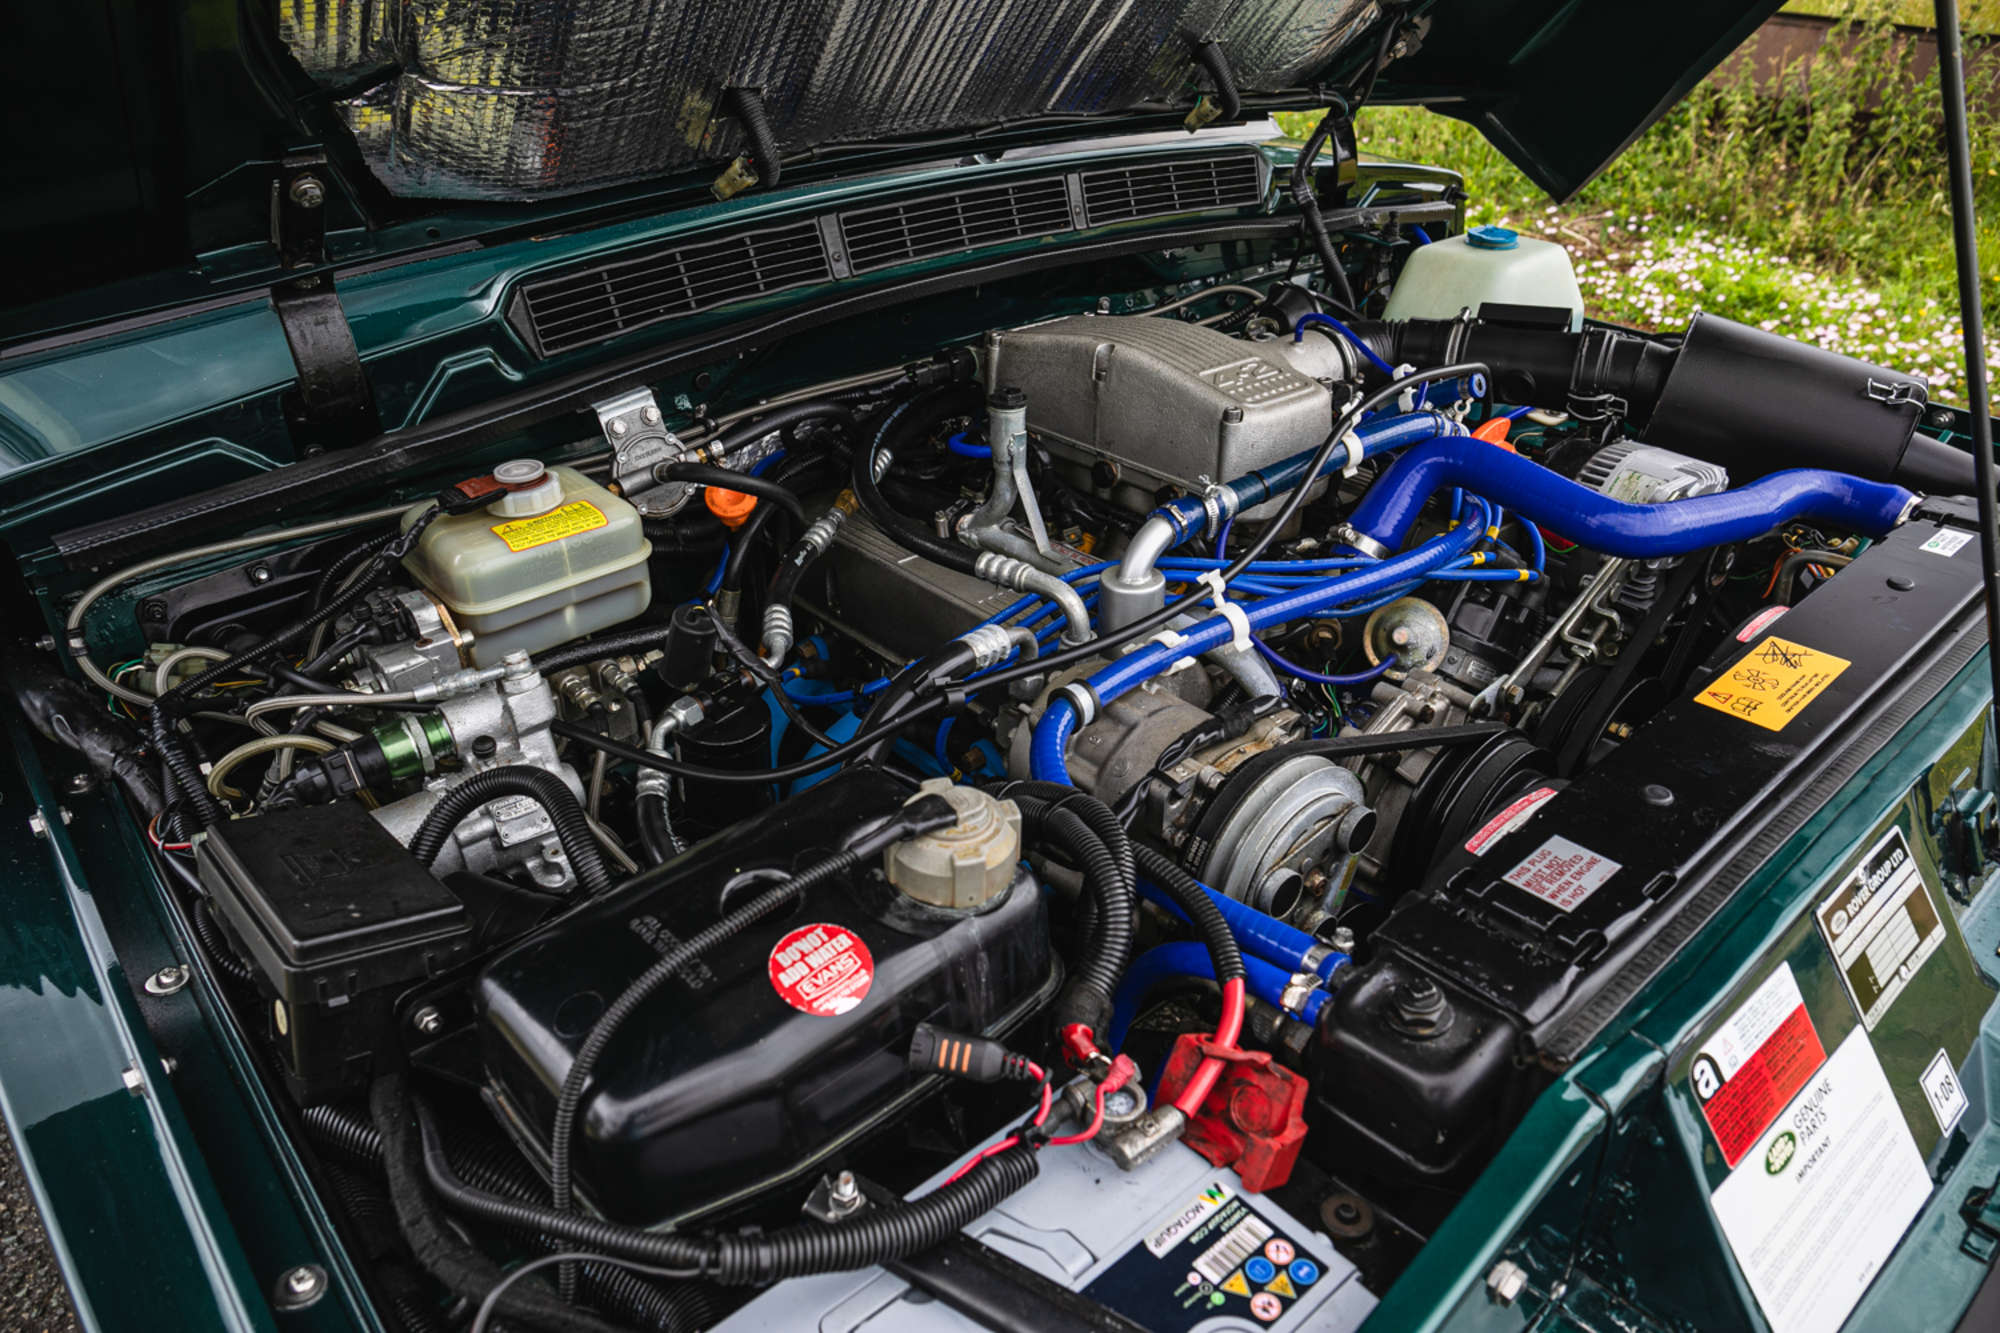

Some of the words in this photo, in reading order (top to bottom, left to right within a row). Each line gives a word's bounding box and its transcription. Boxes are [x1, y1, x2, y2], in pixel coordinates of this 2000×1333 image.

[1508, 866, 1531, 881] THIS
[1528, 848, 1553, 867] PLUG
[1522, 868, 1547, 888] MUST
[1543, 855, 1562, 871] NOT
[1846, 885, 1872, 918] ROVER
[1866, 859, 1893, 892] GROUP
[1889, 847, 1905, 868] LTD
[1547, 879, 1574, 901] WHEN
[1568, 883, 1589, 901] HOT
[775, 945, 802, 969] DO
[792, 927, 830, 955] NOT
[778, 960, 811, 989] ADD
[803, 933, 854, 970] WATER
[801, 954, 855, 994] EVANS
[1793, 1077, 1833, 1131] GENUINE
[1799, 1107, 1829, 1146] PARTS
[1795, 1136, 1833, 1185] IMPORTANT
[1153, 1202, 1206, 1249] MOTAQUIP
